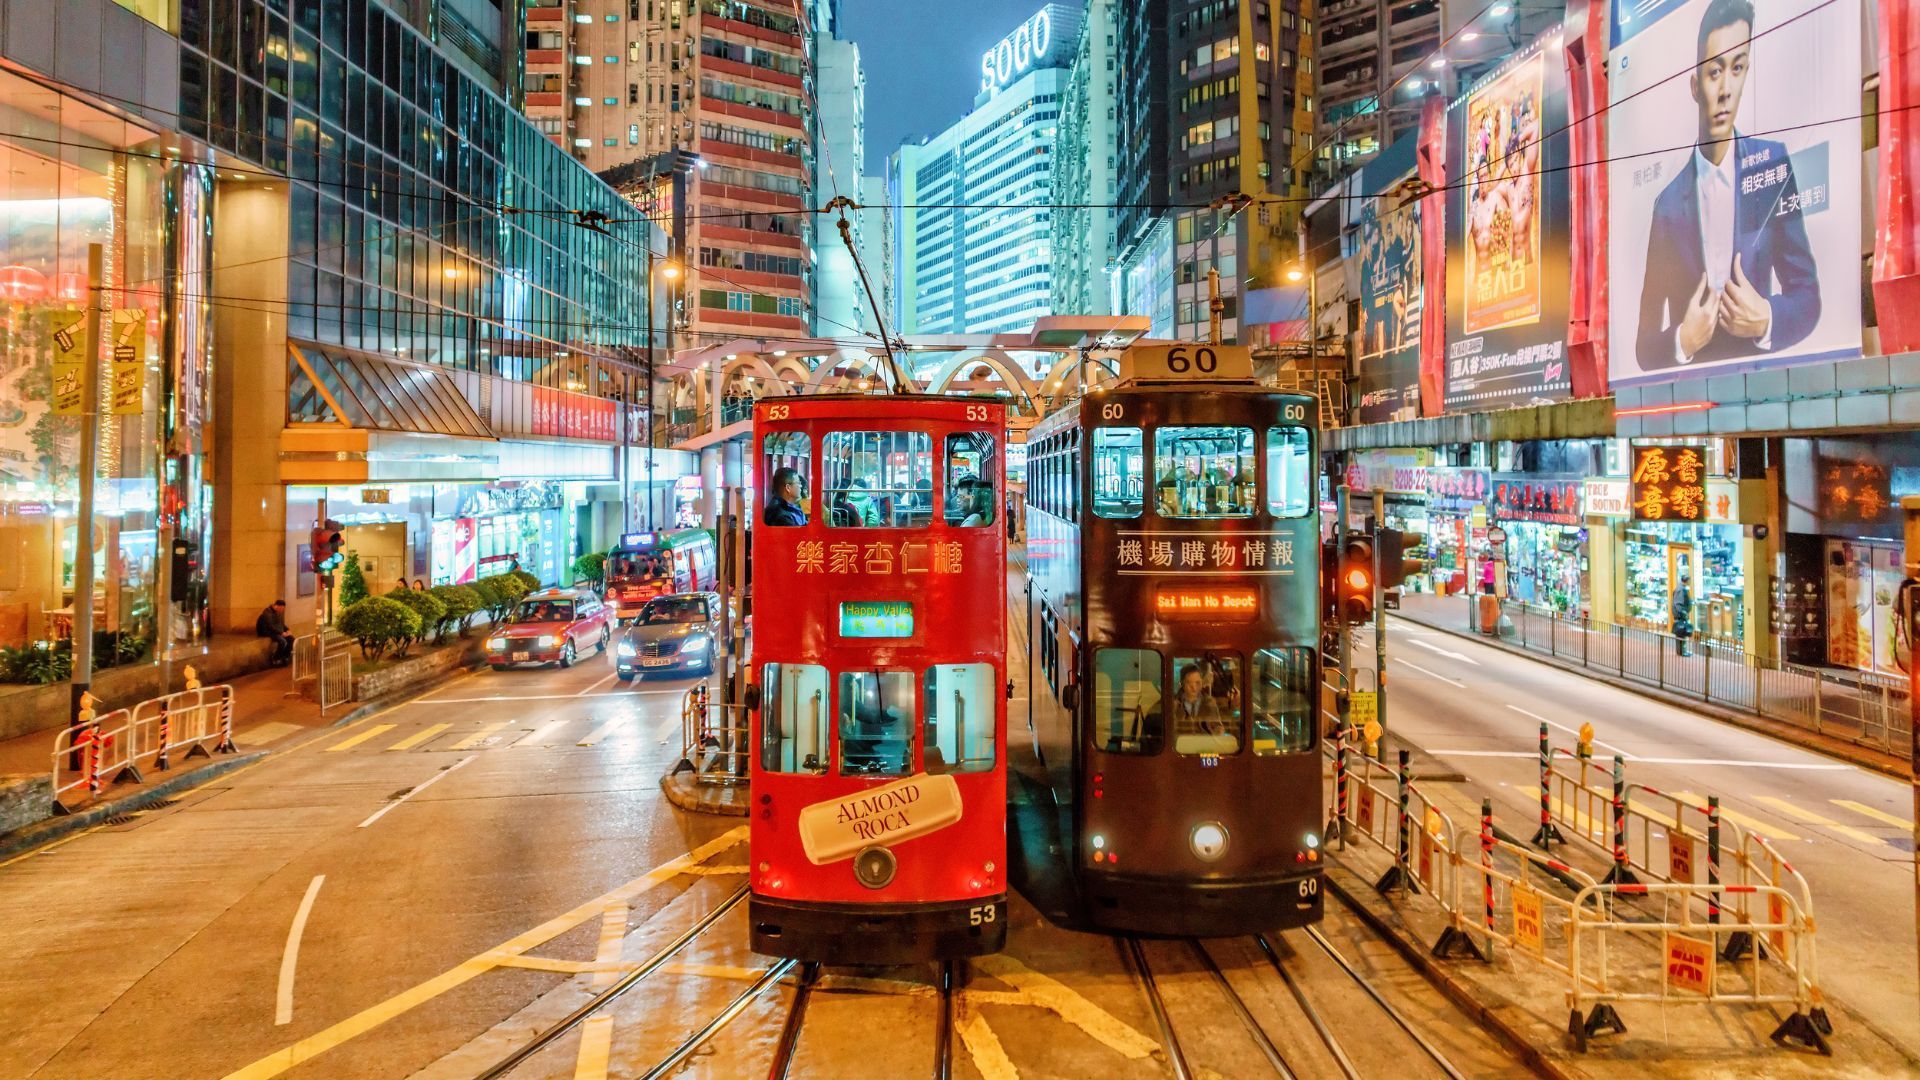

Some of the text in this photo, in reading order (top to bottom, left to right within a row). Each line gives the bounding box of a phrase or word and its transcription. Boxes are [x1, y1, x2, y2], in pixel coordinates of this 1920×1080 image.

[981, 9, 1050, 91] SOGO
[1741, 163, 1788, 195] 相安無事
[1775, 183, 1826, 216] 上次講到
[1166, 347, 1218, 373] 60
[768, 405, 790, 420] 53
[966, 406, 988, 421] 53
[1102, 403, 1124, 420] 60
[1284, 404, 1305, 420] 60
[1587, 483, 1609, 496] TRUE
[1592, 498, 1621, 512] SOUND
[796, 541, 963, 574] 樂家杏仁糖
[1117, 540, 1294, 567] 機場購物情報
[846, 605, 878, 617] Happy
[1158, 595, 1176, 607] Sai
[1223, 595, 1256, 608] Depot
[837, 785, 920, 824] ALMOND
[853, 811, 911, 840] ROCA
[1299, 878, 1317, 897] 60
[970, 905, 995, 926] 53
